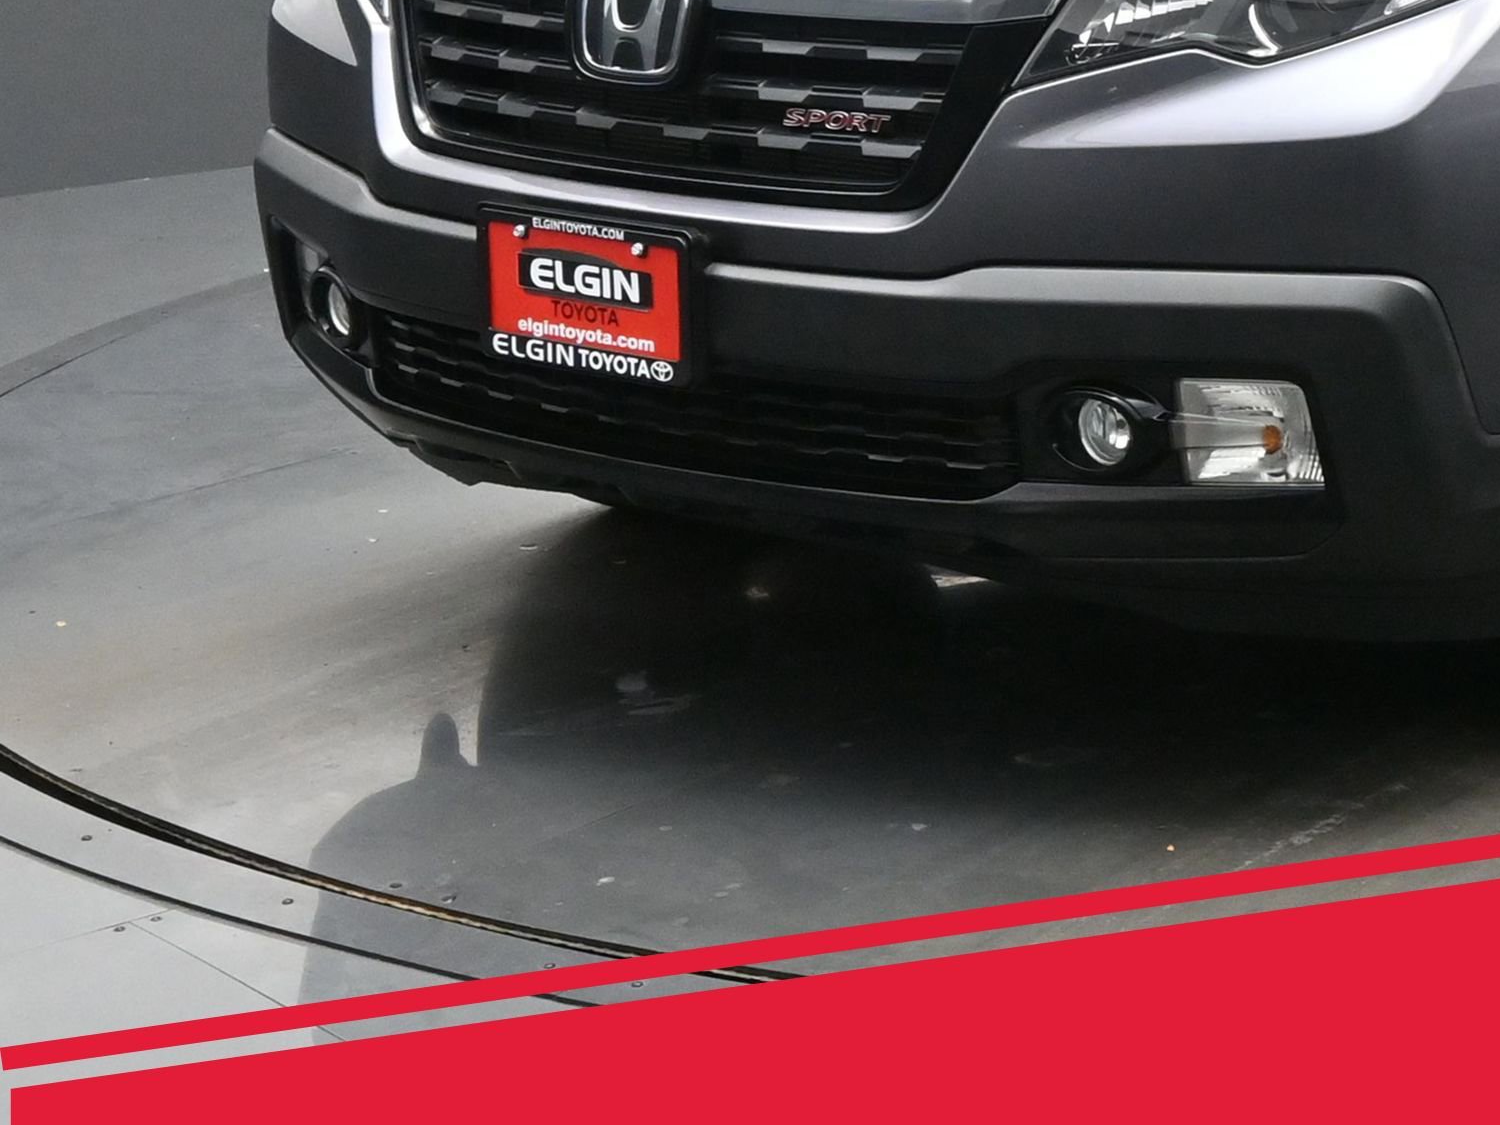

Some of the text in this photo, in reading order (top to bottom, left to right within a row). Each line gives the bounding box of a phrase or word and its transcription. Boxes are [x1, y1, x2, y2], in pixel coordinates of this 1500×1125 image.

[783, 107, 891, 133] SPORT
[532, 217, 625, 241] ELGINTOYOTA.COM
[530, 257, 641, 304] ELGIN
[551, 299, 620, 327] TOYOTA
[517, 317, 656, 353] elgintoyota.com
[492, 333, 652, 379] ELGIN TOYOTA
